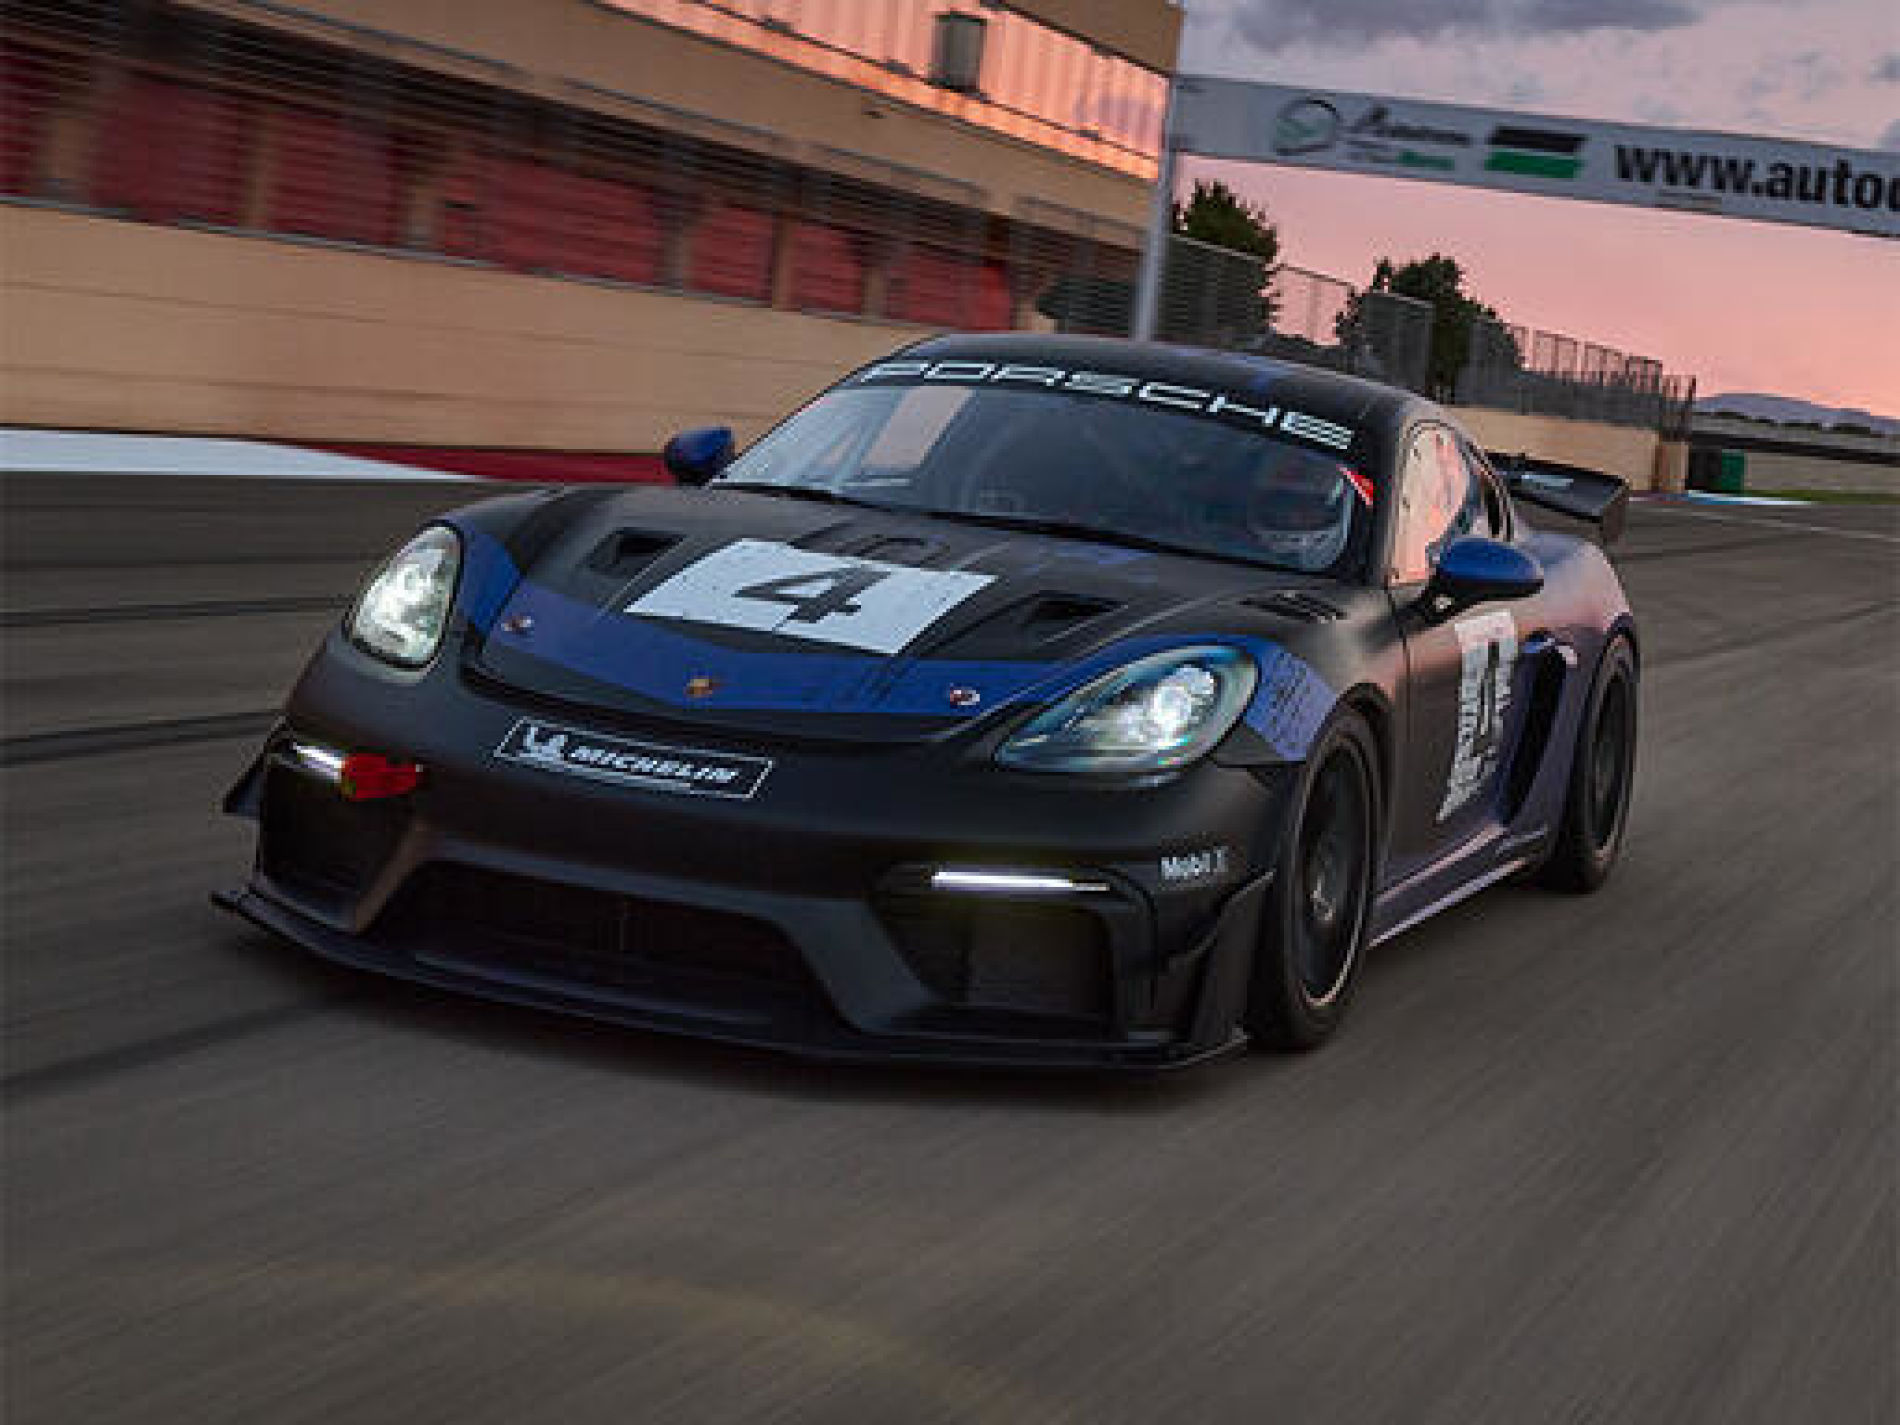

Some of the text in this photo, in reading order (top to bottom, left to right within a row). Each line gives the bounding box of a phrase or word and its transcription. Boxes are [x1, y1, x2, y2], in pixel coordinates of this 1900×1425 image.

[862, 361, 1353, 450] PORSCHE
[732, 564, 890, 624] 4
[570, 746, 738, 784] MICHELIN
[1160, 852, 1211, 880] Mobil
